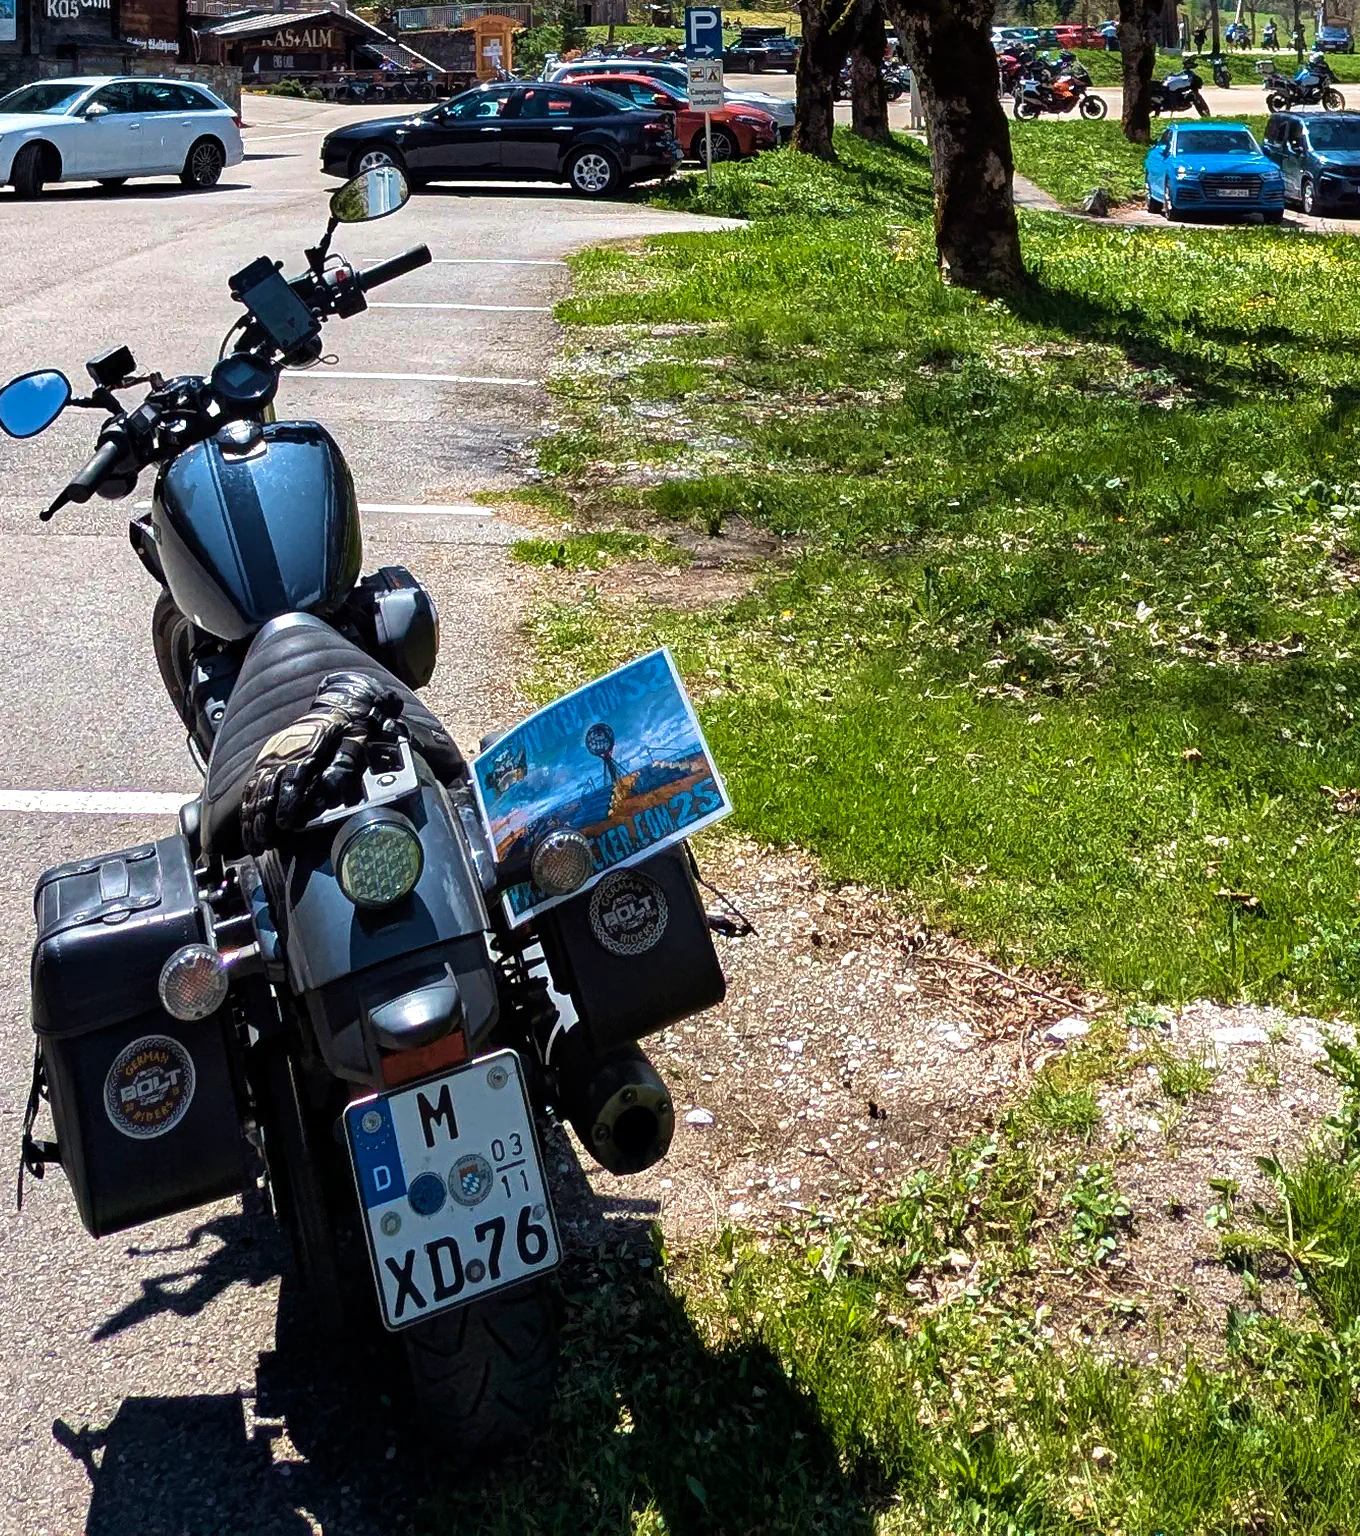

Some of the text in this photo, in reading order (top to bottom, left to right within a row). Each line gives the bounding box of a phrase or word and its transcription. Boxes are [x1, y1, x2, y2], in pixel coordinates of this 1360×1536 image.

[690, 10, 718, 45] P
[602, 895, 652, 927] BOLT
[120, 1068, 181, 1102] BOLT
[416, 1083, 459, 1148] M
[490, 1132, 523, 1162] 03
[372, 1165, 391, 1192] D
[500, 1169, 529, 1199] 11
[473, 1205, 549, 1281] 76
